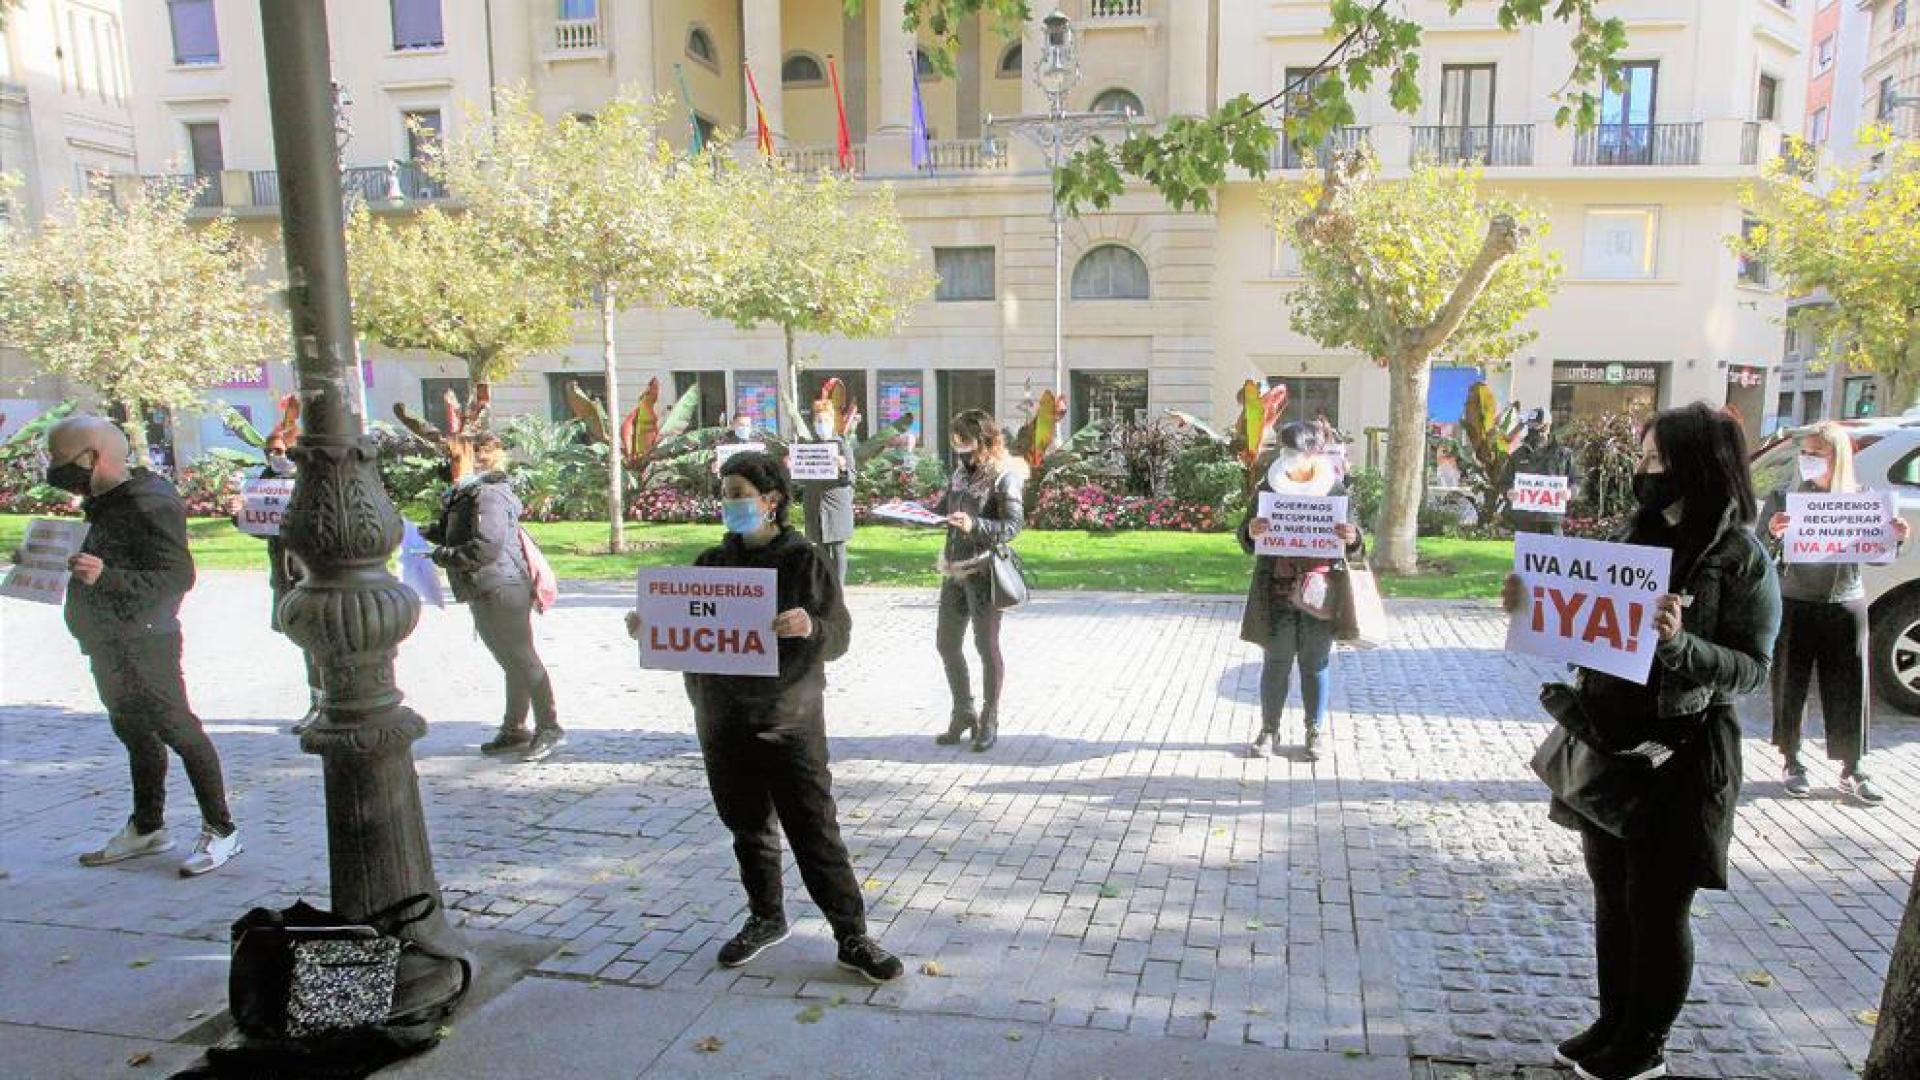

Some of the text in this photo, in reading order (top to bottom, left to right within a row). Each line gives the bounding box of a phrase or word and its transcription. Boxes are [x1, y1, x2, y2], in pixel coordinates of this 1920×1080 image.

[1568, 362, 1656, 380] urban sans
[1519, 488, 1561, 507] ¡YA!
[1273, 501, 1333, 512] QUEREMOS
[1806, 501, 1881, 511] QUEREMOS
[245, 510, 282, 525] LUC
[1271, 512, 1334, 523] RECUPERAR
[1803, 515, 1882, 525] RECUPERAR
[1799, 528, 1816, 536] LO
[1263, 536, 1286, 547] IVA
[1793, 542, 1886, 553] IVA AL 10%
[1523, 552, 1658, 592] IVA AL 10%
[649, 581, 764, 598] PELUQUERÍAS
[688, 600, 718, 618] EN
[1531, 586, 1644, 653] ¡YA!
[650, 625, 765, 655] LUCHA
